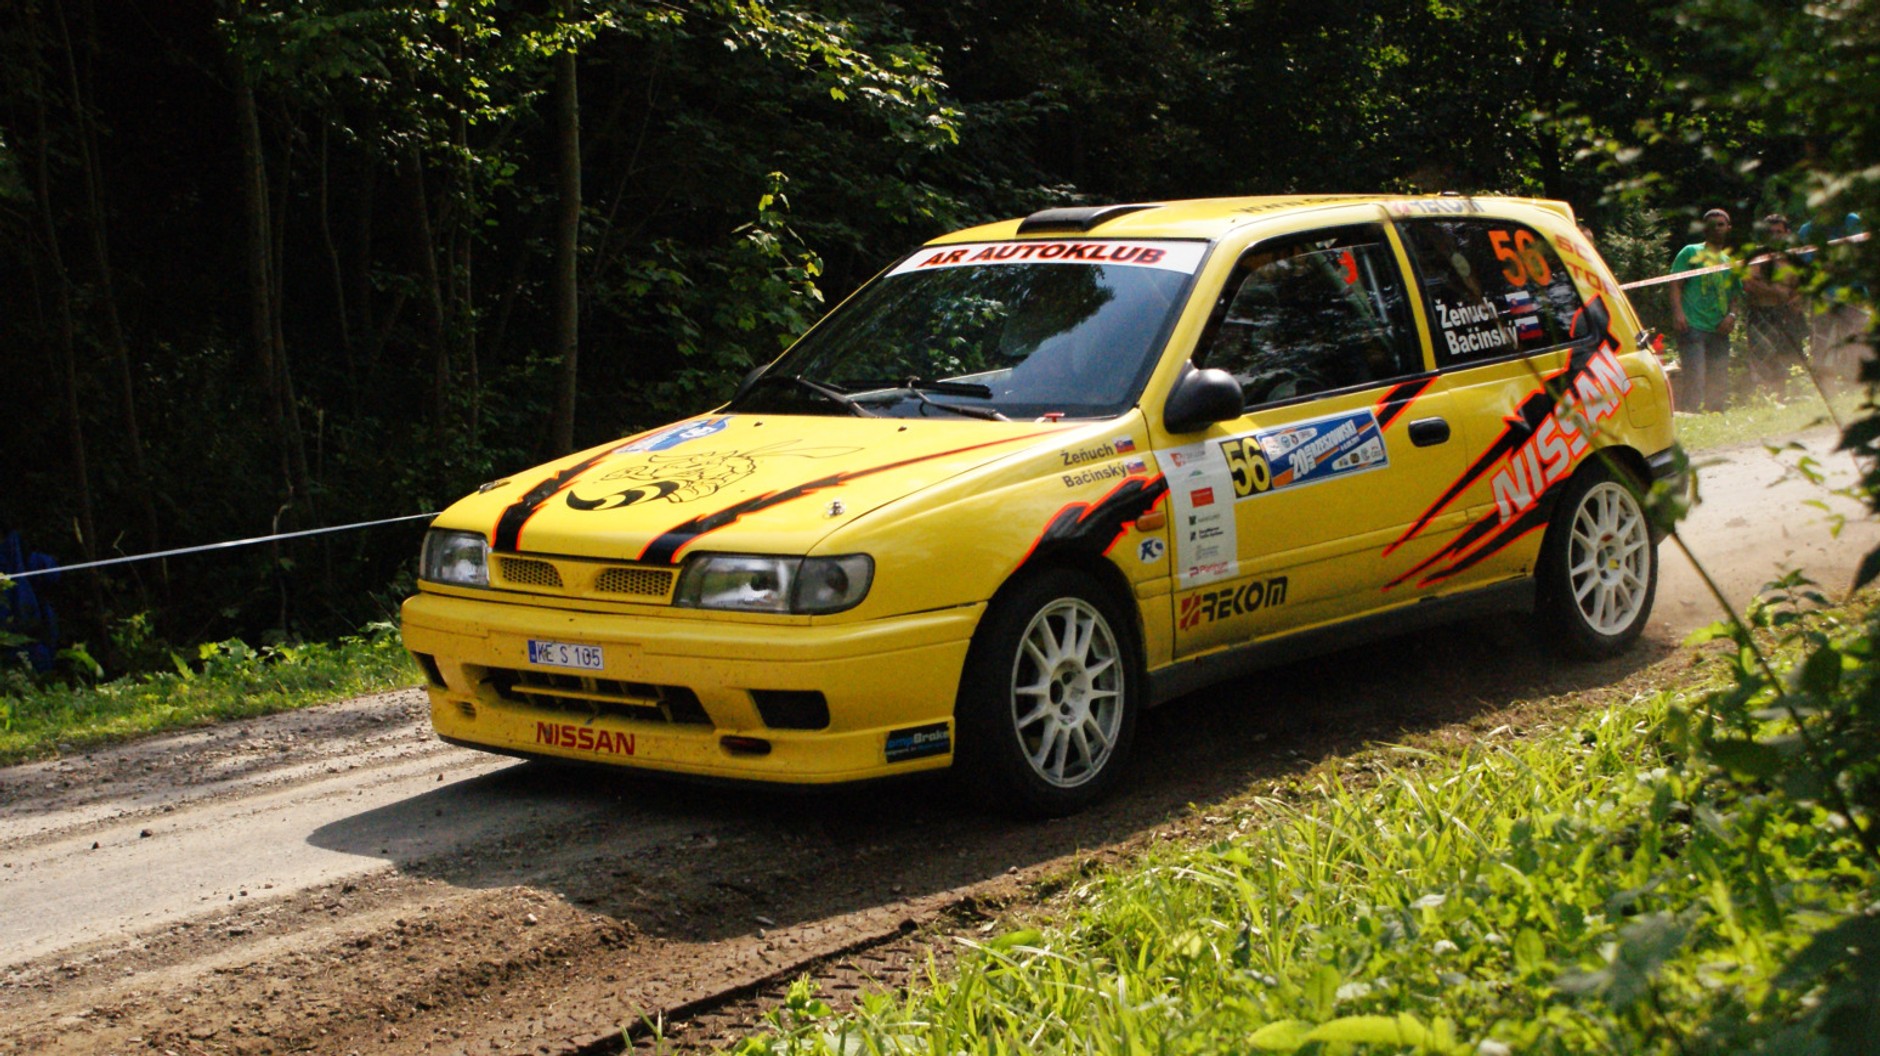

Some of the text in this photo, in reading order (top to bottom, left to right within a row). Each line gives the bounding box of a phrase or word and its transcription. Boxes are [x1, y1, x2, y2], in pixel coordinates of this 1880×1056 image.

[918, 243, 1167, 268] AR AUTOKLUB
[1488, 229, 1552, 287] 56
[1435, 297, 1499, 329] Žeňuch
[1444, 320, 1519, 355] Bačinský
[1491, 342, 1632, 526] NISSAN
[1060, 443, 1115, 466] Žeňuch
[1222, 437, 1270, 496] 56
[1289, 448, 1310, 480] 20
[1062, 462, 1128, 488] Bačinský
[537, 644, 601, 667] KE S 105
[536, 721, 635, 756] NISSAN
